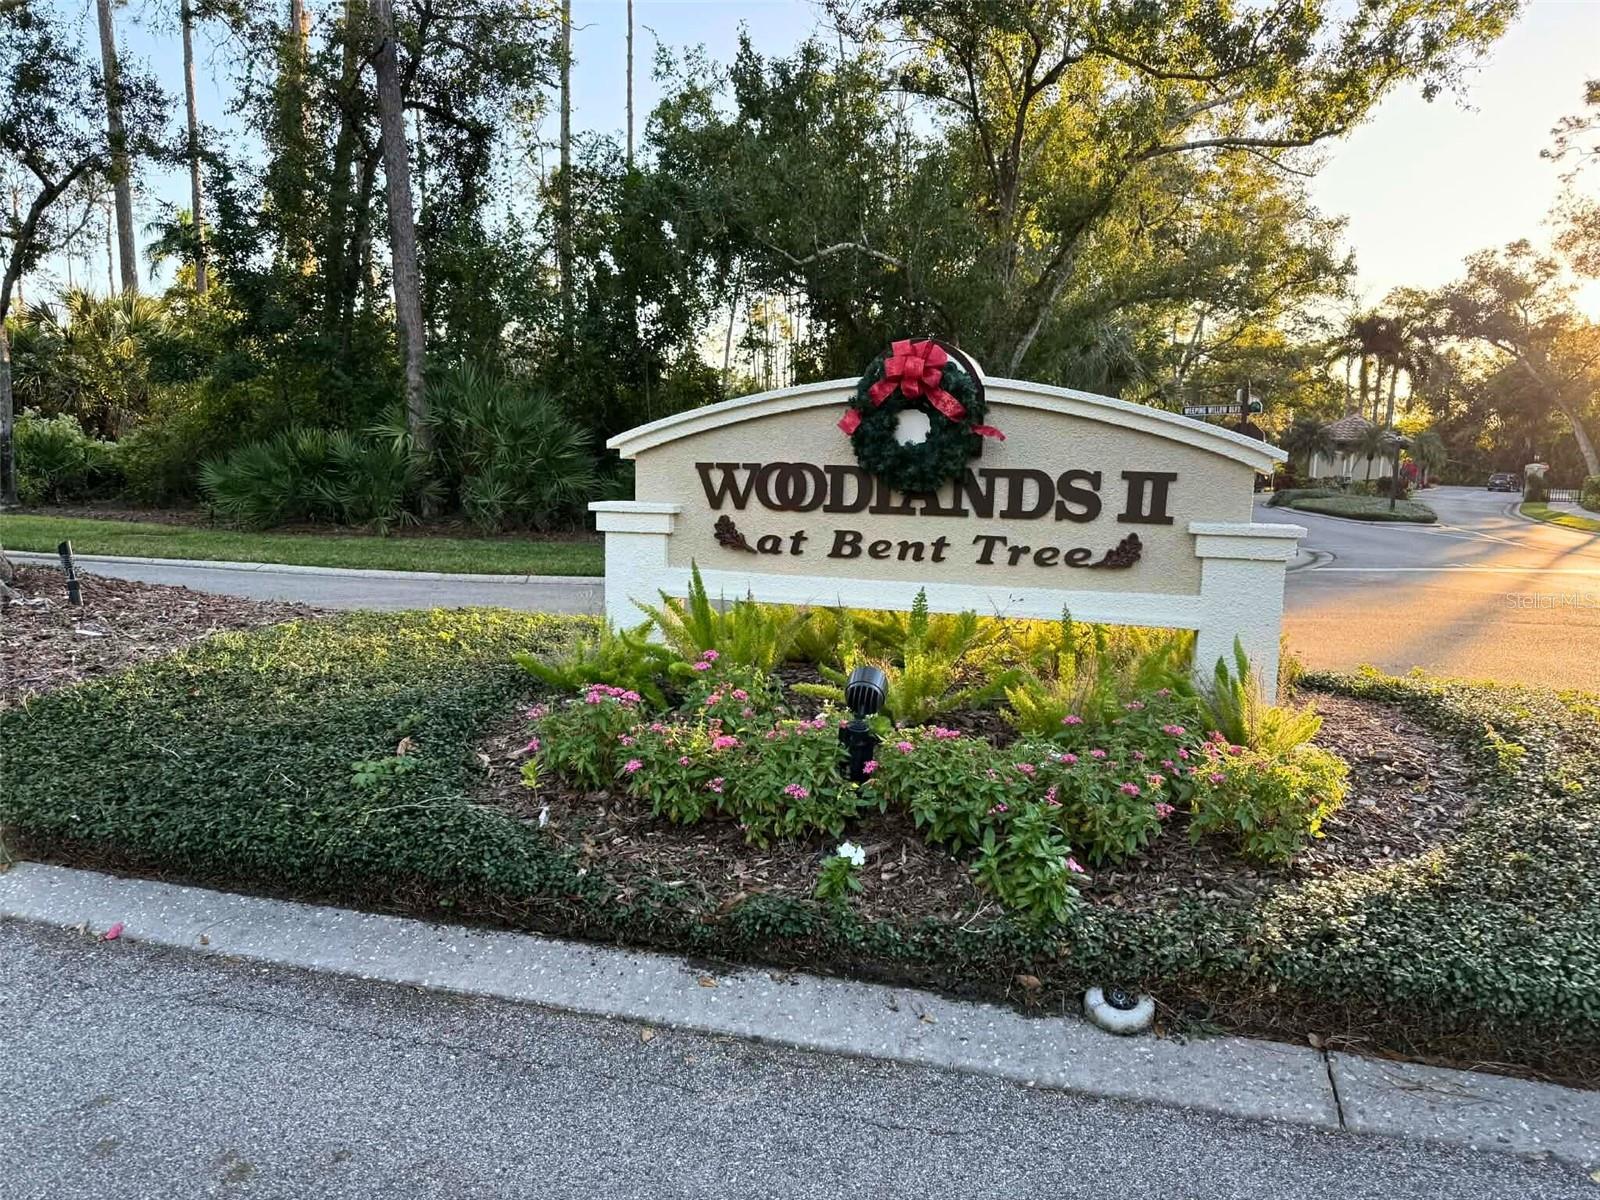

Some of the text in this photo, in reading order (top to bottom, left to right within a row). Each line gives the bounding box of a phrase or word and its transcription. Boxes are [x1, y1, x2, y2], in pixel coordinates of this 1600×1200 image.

[1117, 470, 1178, 526] II
[756, 529, 1093, 569] at Bent Tree
